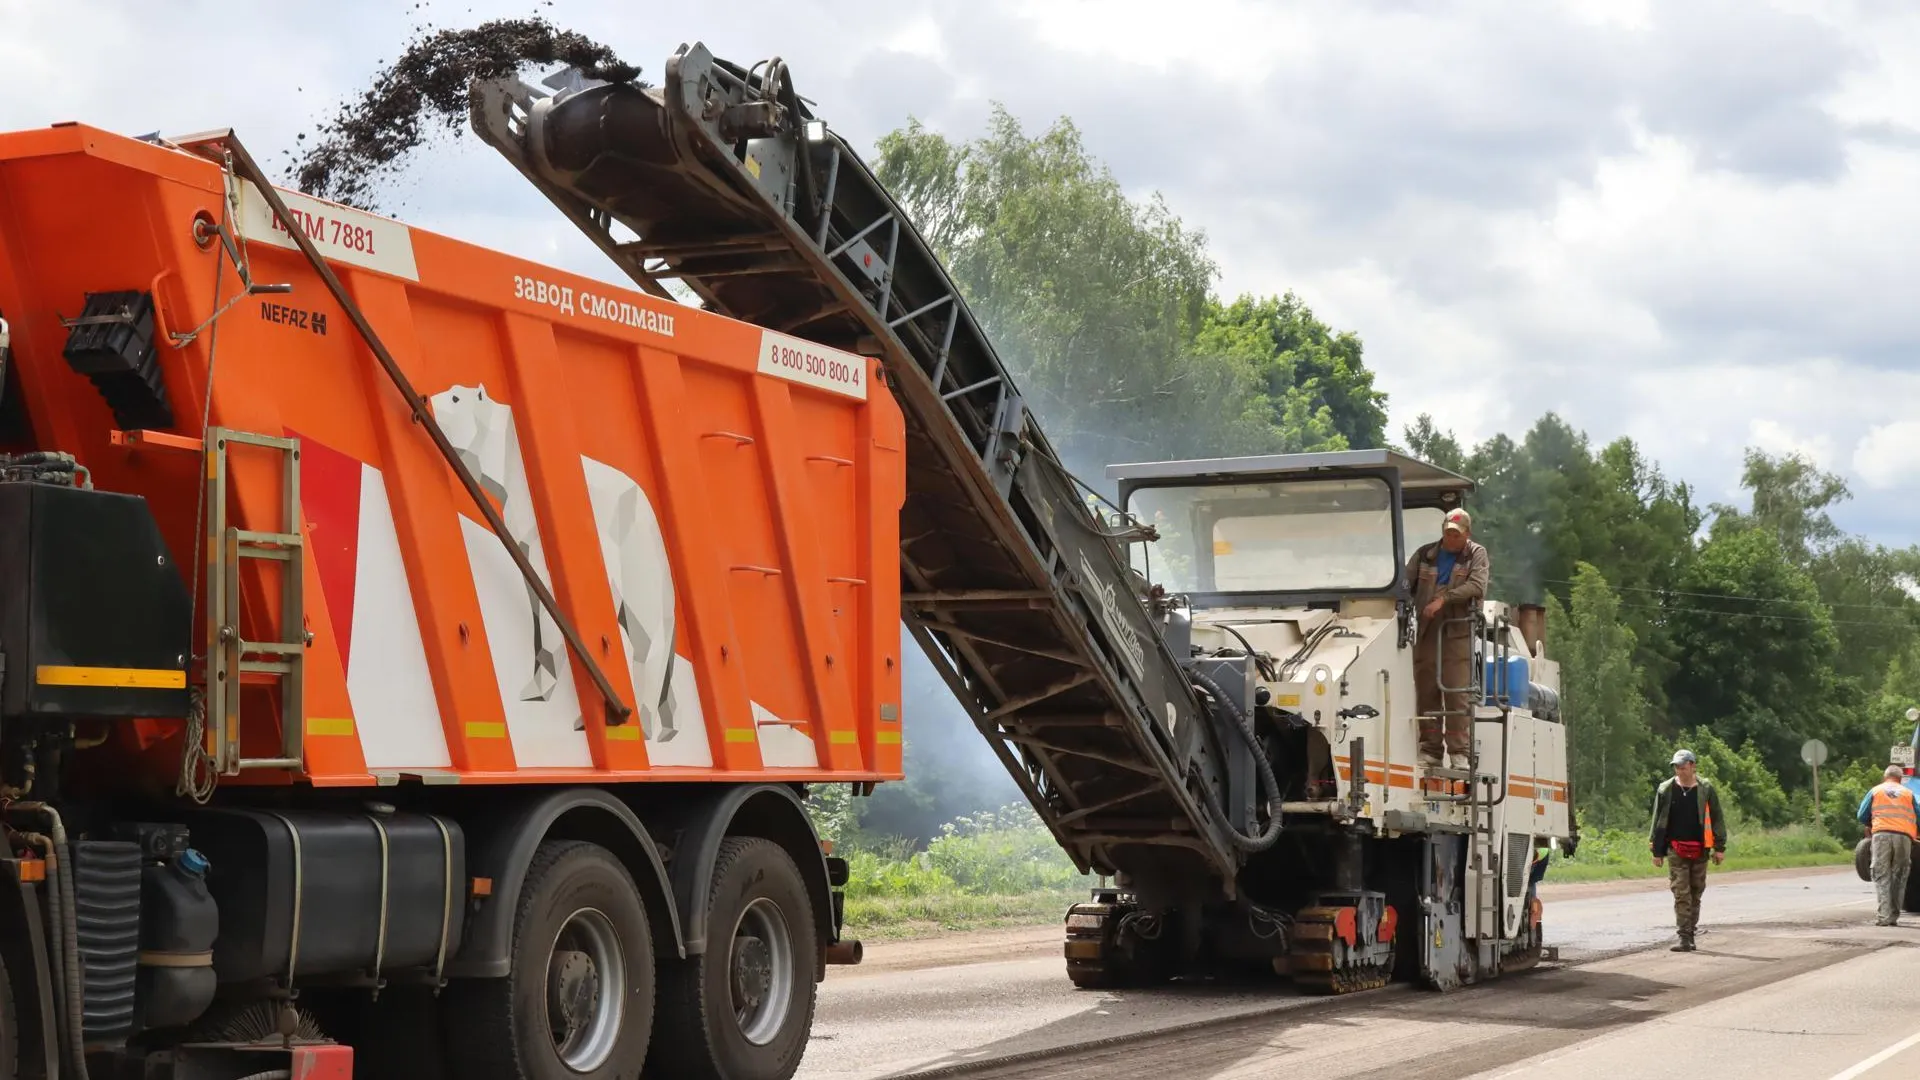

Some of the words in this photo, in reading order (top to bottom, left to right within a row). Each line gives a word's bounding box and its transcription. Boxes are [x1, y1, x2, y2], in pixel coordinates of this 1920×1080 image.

[330, 219, 375, 255] 7881
[261, 301, 308, 330] NEFAZ
[772, 344, 779, 364] 8
[782, 347, 803, 371] 800
[806, 354, 826, 377] 500
[829, 360, 849, 383] 800
[852, 367, 859, 387] 4
